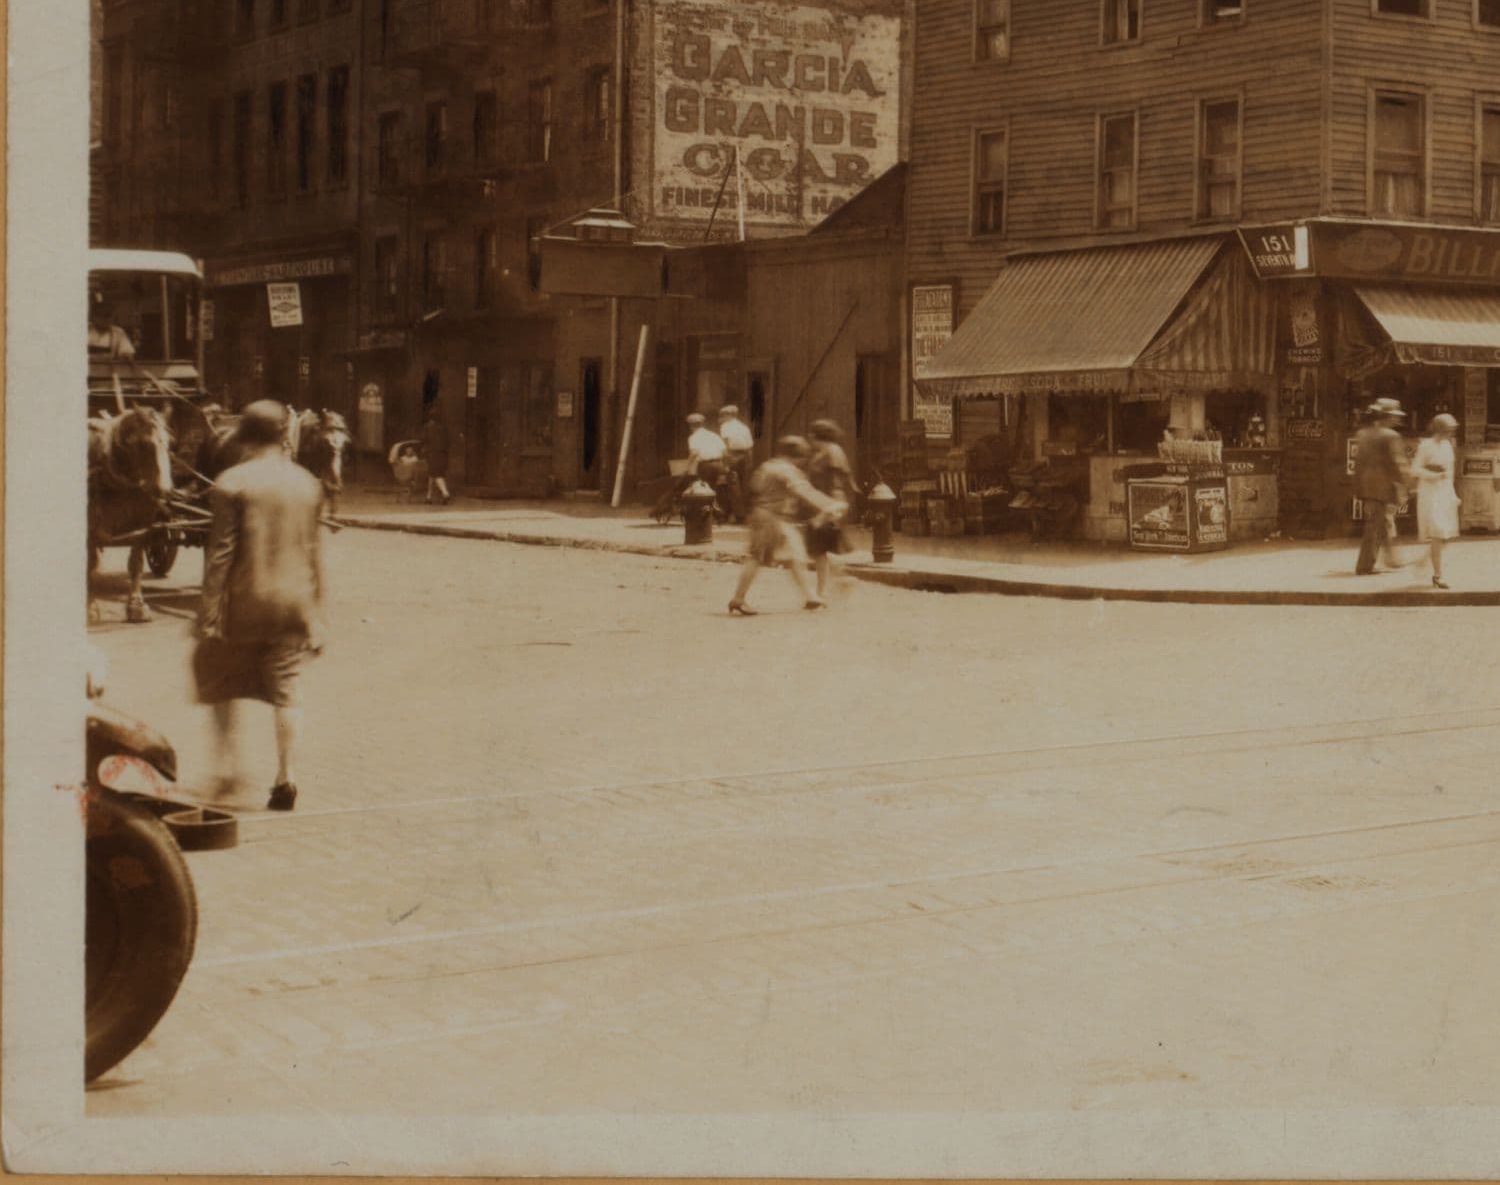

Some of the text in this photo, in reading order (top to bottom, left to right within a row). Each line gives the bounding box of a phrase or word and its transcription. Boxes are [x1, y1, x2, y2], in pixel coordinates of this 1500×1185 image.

[668, 32, 887, 97] GARCIA
[664, 86, 878, 149] GRANDE
[662, 186, 738, 211] FINEST
[1262, 236, 1290, 252] 151
